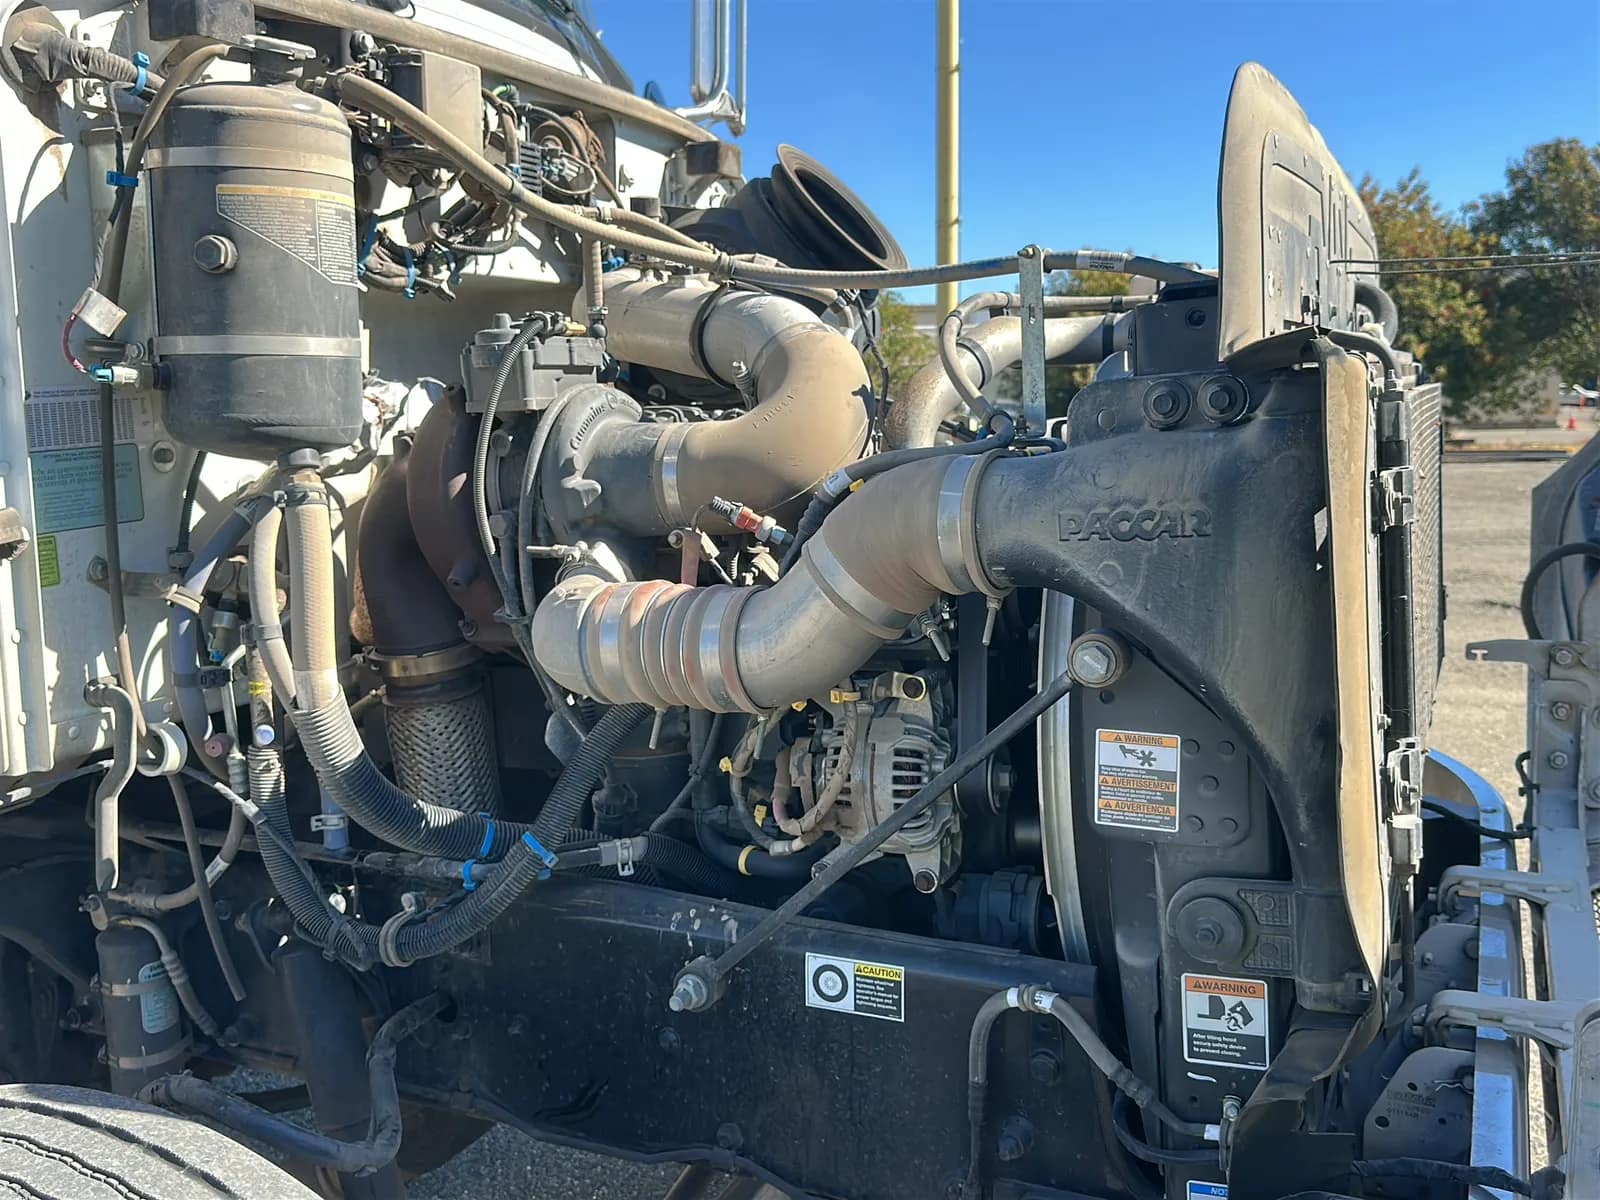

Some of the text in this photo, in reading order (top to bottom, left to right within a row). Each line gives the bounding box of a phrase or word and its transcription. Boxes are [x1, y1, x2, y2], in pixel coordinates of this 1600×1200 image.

[569, 403, 607, 450] Cummins
[1058, 509, 1212, 542] PACCAR
[1123, 734, 1164, 745] WARNING
[1111, 777, 1175, 791] AVERTISSEMENT
[1114, 801, 1171, 815] ADVERTENCIA
[863, 966, 900, 979] CAUTION
[1202, 980, 1256, 995] WARNING
